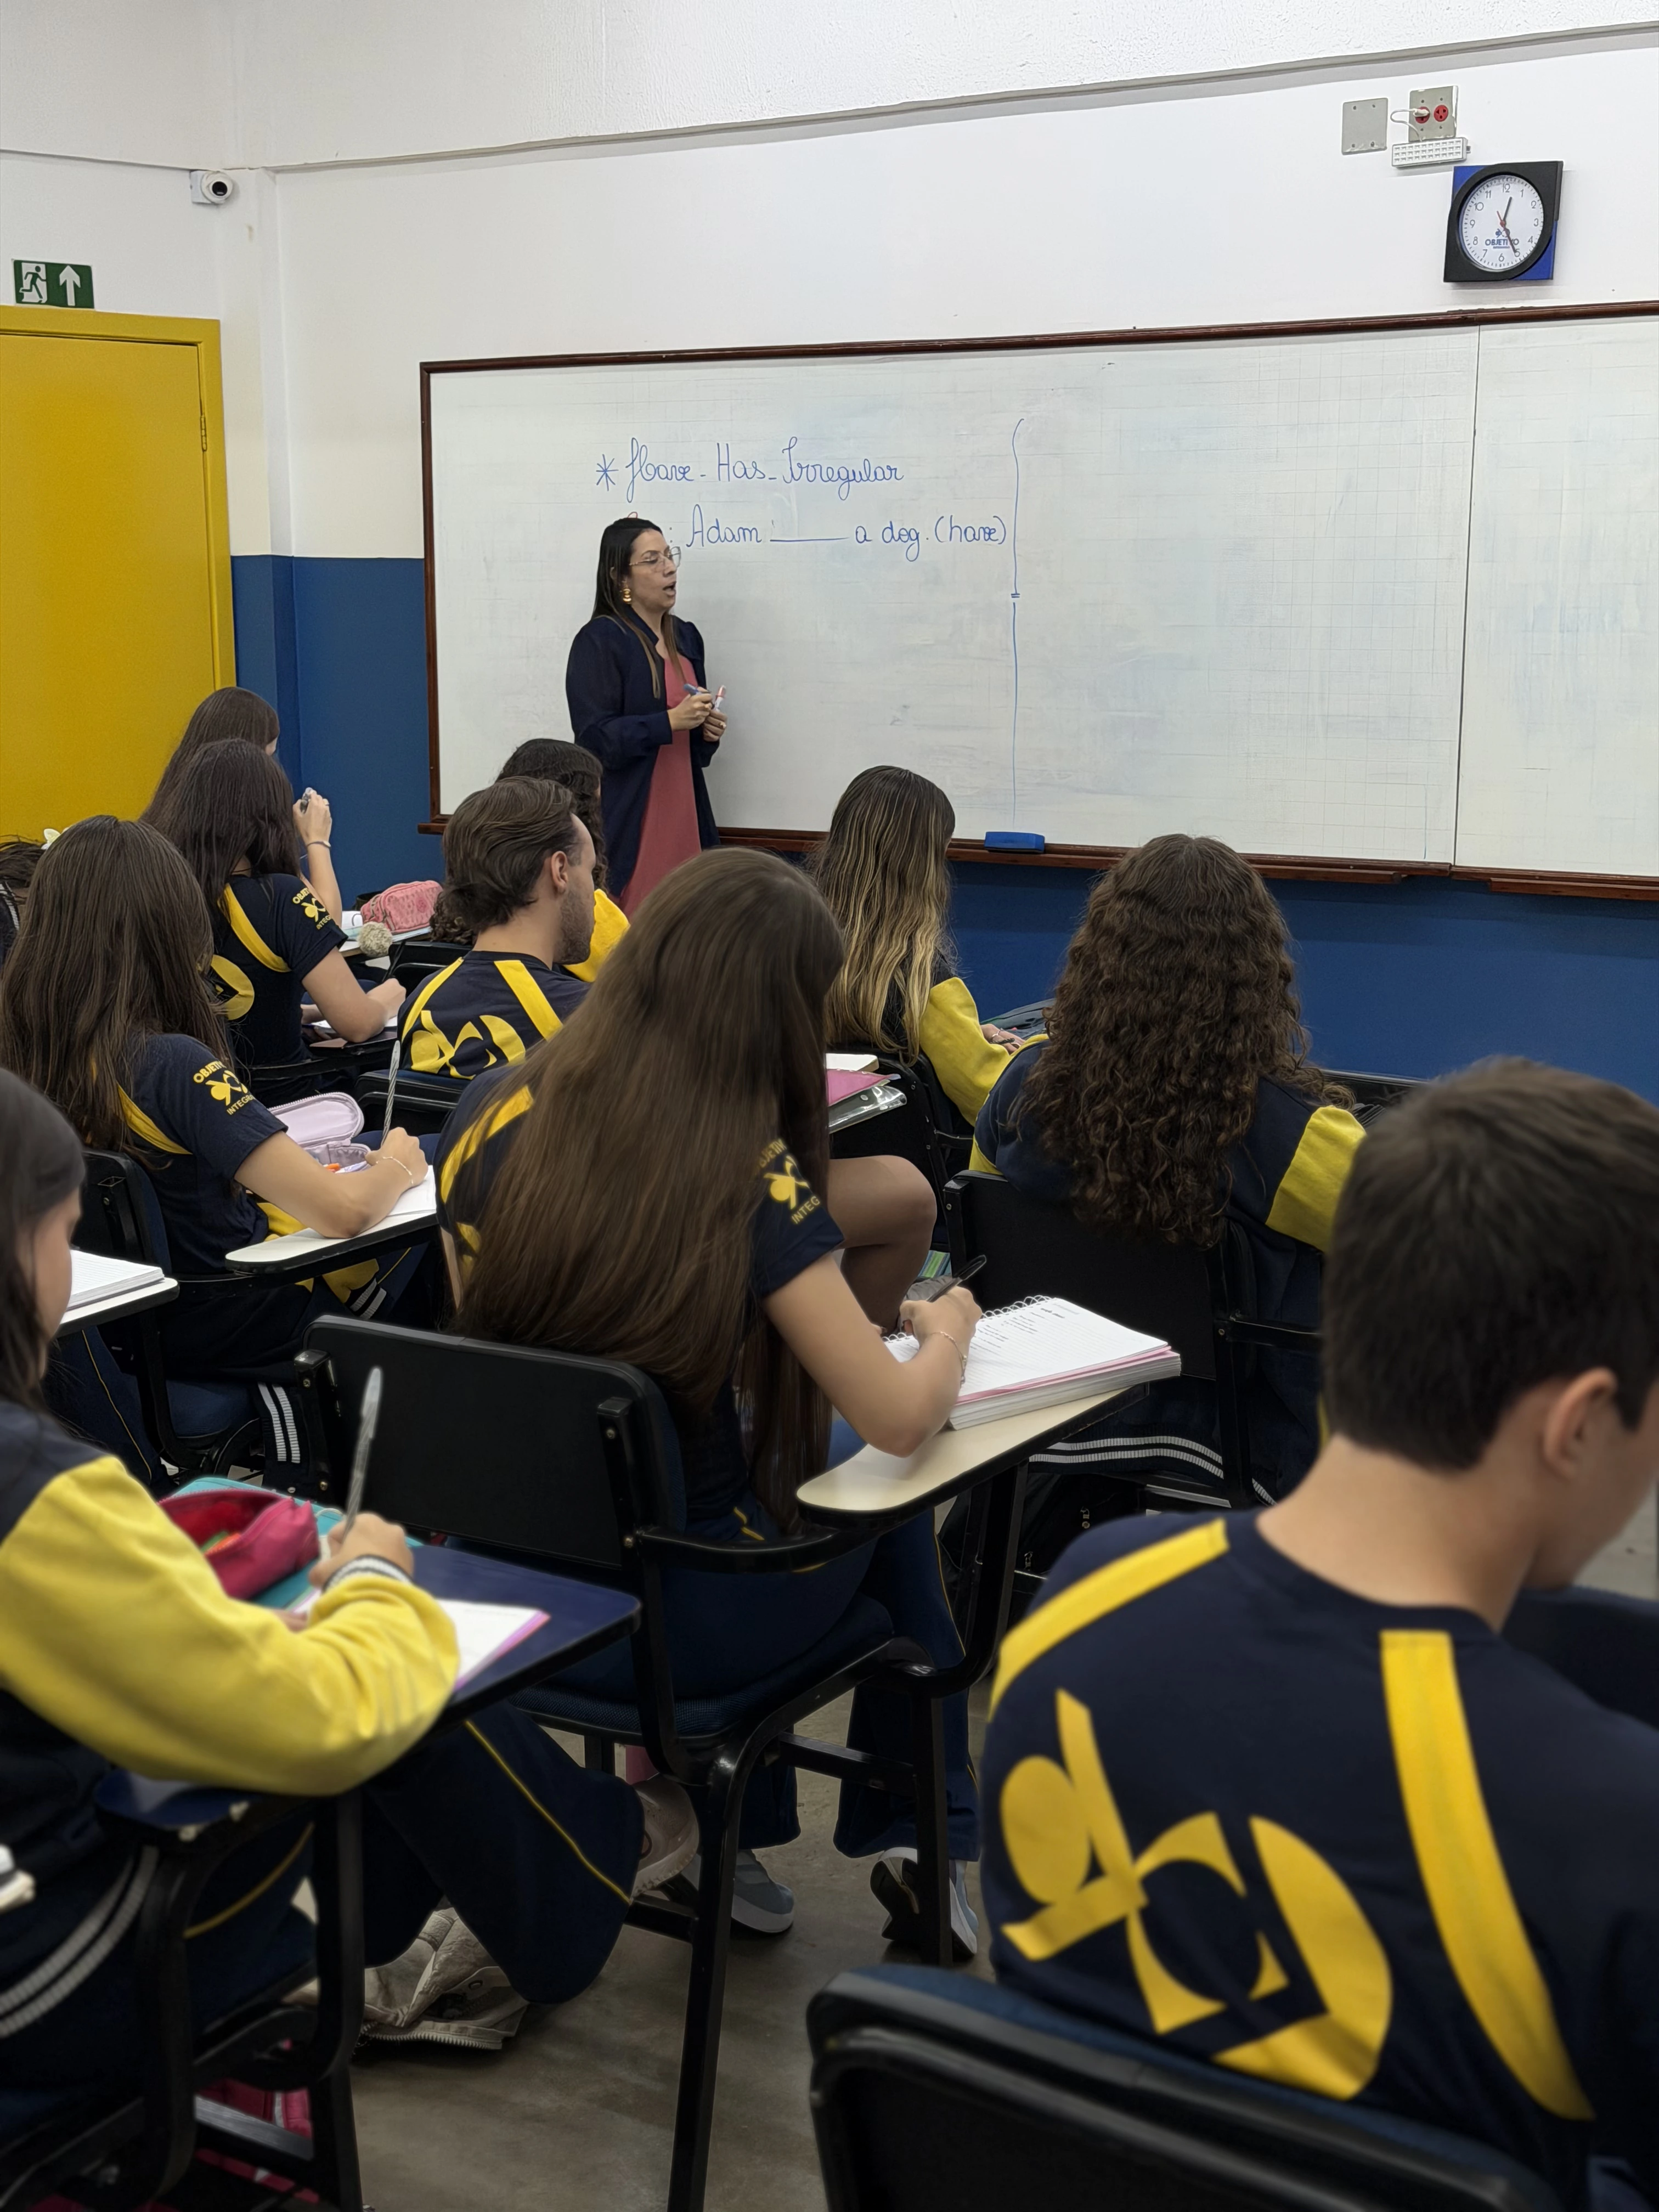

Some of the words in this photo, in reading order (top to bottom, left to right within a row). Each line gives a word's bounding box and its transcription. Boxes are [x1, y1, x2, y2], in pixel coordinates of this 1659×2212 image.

[1502, 183, 1511, 193] 12
[1485, 190, 1492, 199] 11
[1474, 201, 1485, 211] 10
[1531, 200, 1537, 209] 2
[1469, 219, 1476, 228] 9
[1533, 218, 1539, 227] 3
[1472, 236, 1479, 246] 8
[1527, 235, 1533, 244] 4
[1482, 249, 1488, 258] 7
[1498, 253, 1505, 262] 6
[1514, 249, 1520, 257] 5
[686, 504, 763, 548] Adam
[855, 526, 873, 544] a
[791, 1195, 821, 1224] INTEG
